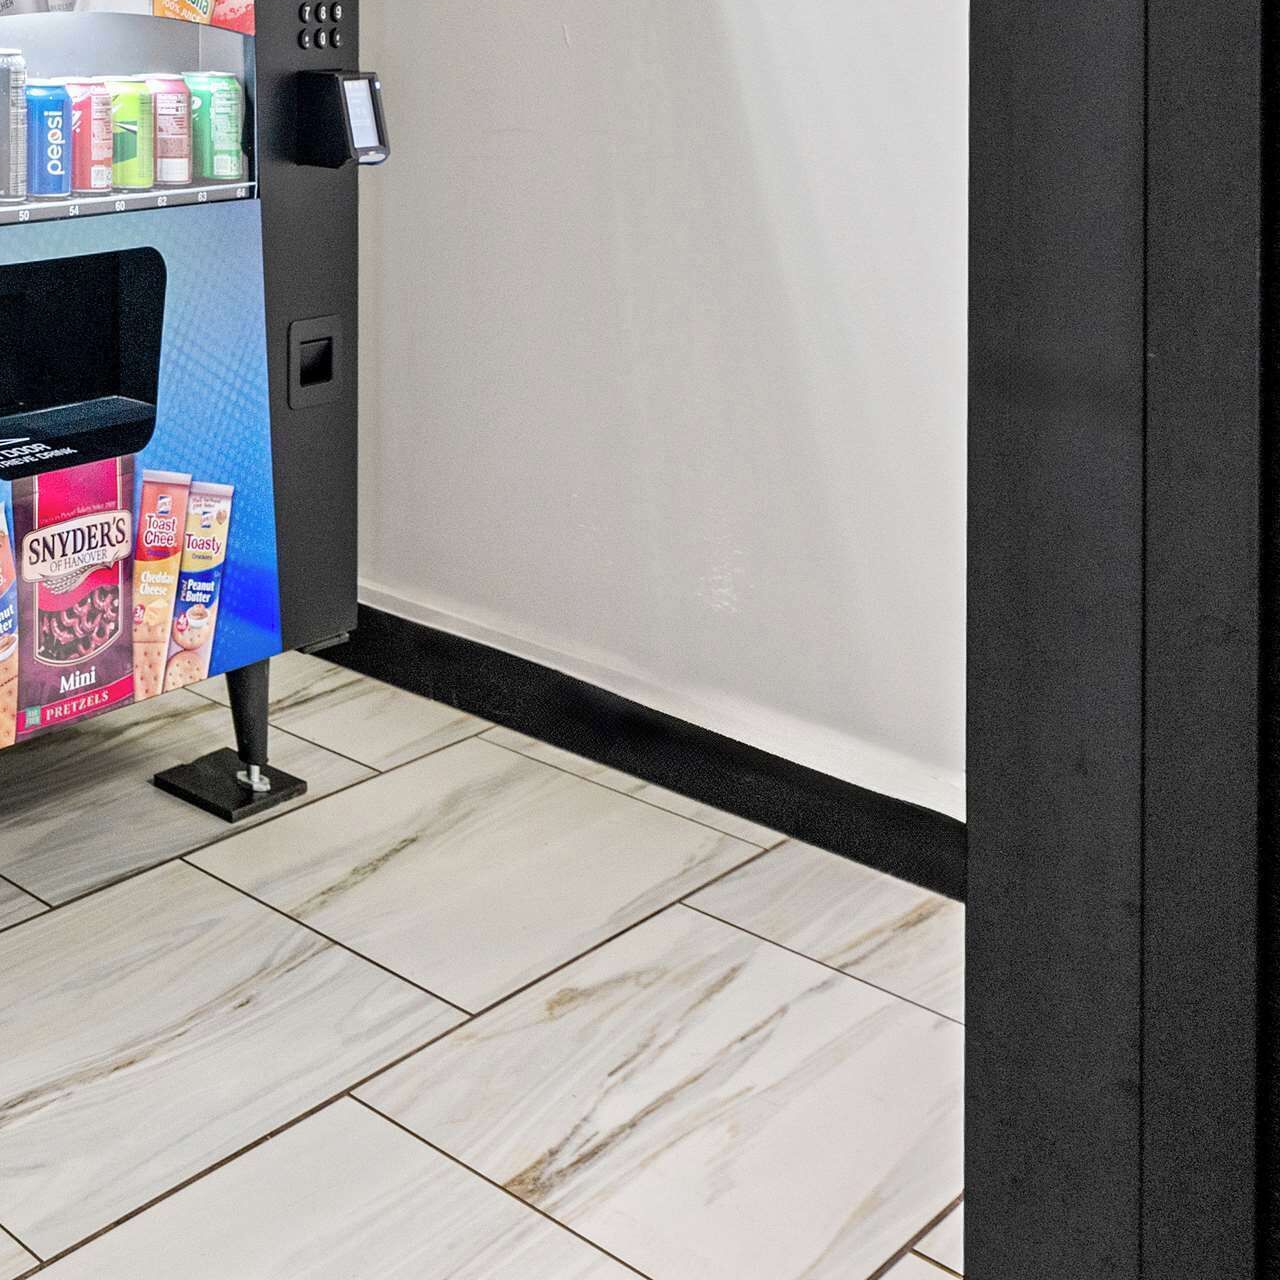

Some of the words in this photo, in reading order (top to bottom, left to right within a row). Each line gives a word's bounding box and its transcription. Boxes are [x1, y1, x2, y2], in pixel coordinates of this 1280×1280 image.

[304, 6, 311, 20] 7
[320, 6, 327, 20] 8
[335, 5, 342, 19] 9
[320, 31, 326, 45] 0
[44, 111, 65, 176] pepsi
[115, 201, 126, 211] 60
[157, 196, 167, 206] 62
[19, 210, 30, 221] 50
[69, 205, 79, 216] 54
[0, 443, 52, 458] DOOR
[146, 515, 177, 533] Toast
[28, 516, 127, 566] SNYDER'S
[144, 530, 175, 547] Chee
[185, 534, 222, 555] Toasty
[49, 559, 62, 573] OF
[63, 548, 109, 569] HANOVER
[142, 572, 175, 585] Cheddar
[187, 578, 215, 592] Peanut
[140, 583, 167, 596] Cheese
[185, 590, 211, 603] Butter
[60, 665, 97, 694] Mini
[45, 689, 110, 721] PRETZELS
